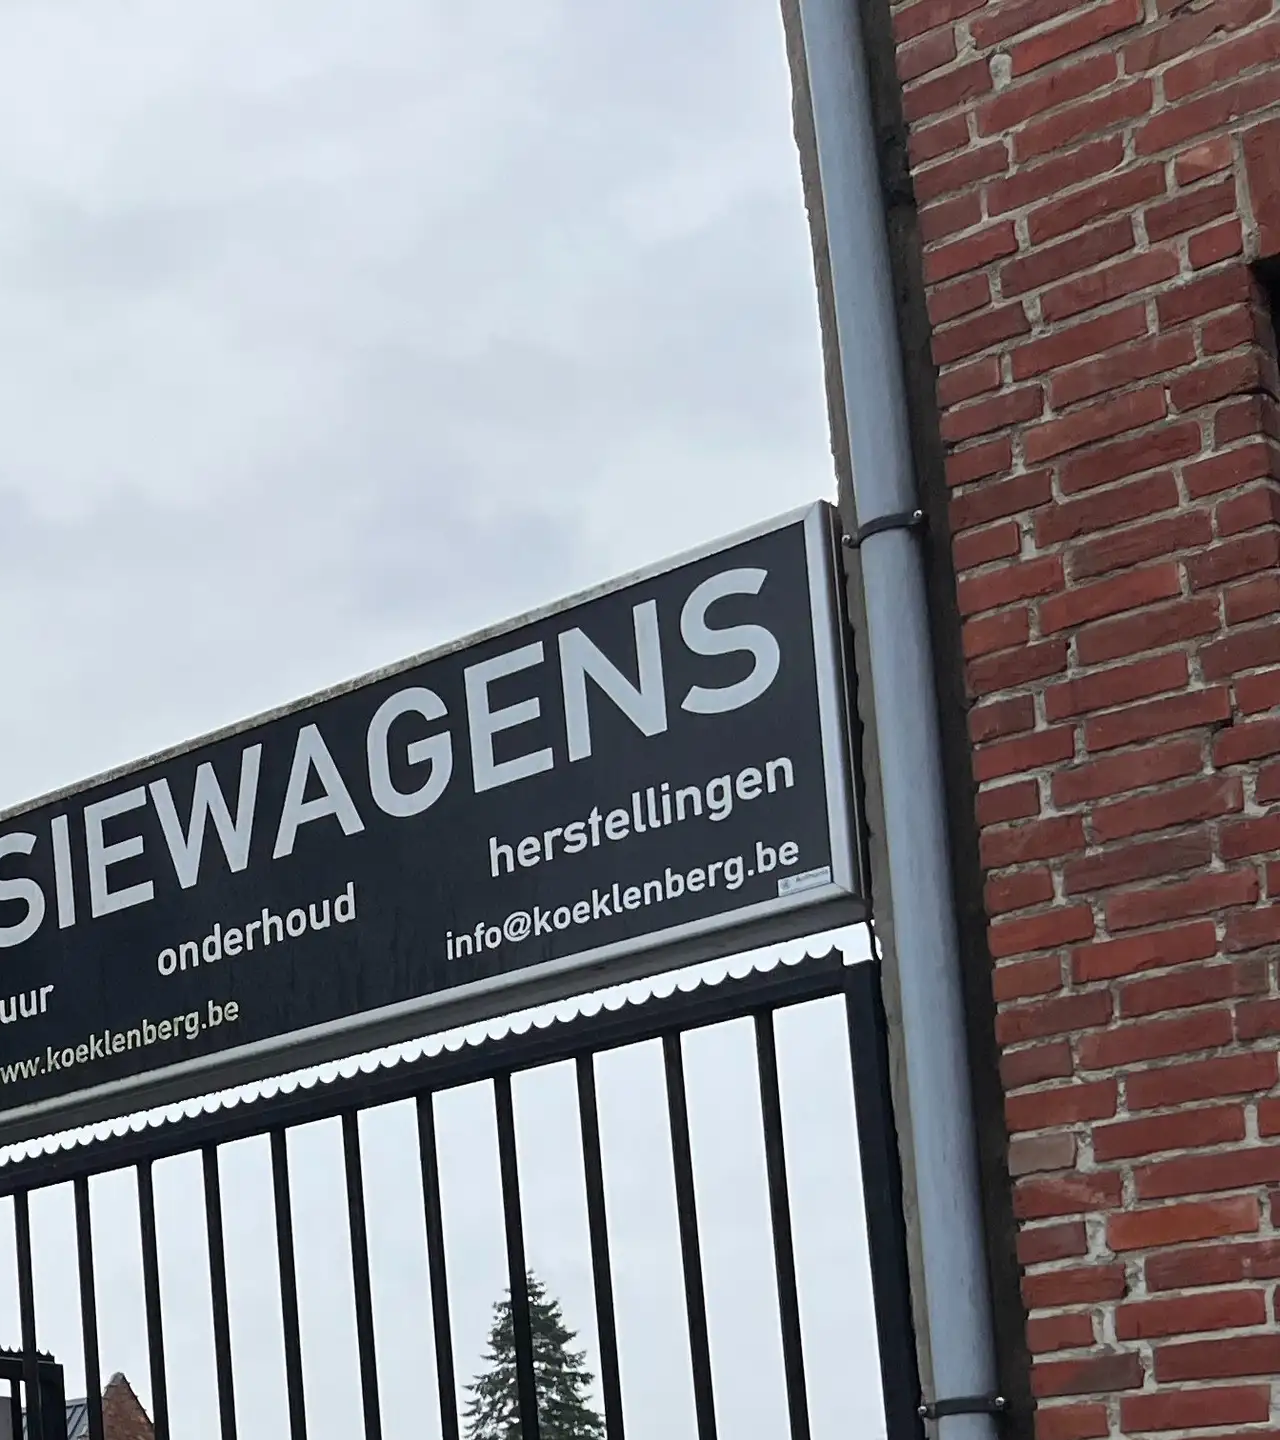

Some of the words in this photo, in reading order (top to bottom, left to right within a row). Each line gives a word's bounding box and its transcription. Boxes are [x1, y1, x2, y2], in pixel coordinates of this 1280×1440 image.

[489, 756, 795, 878] herstellingen
[157, 881, 357, 976] onderhoud
[446, 841, 800, 961] info@koeklenberg.be
